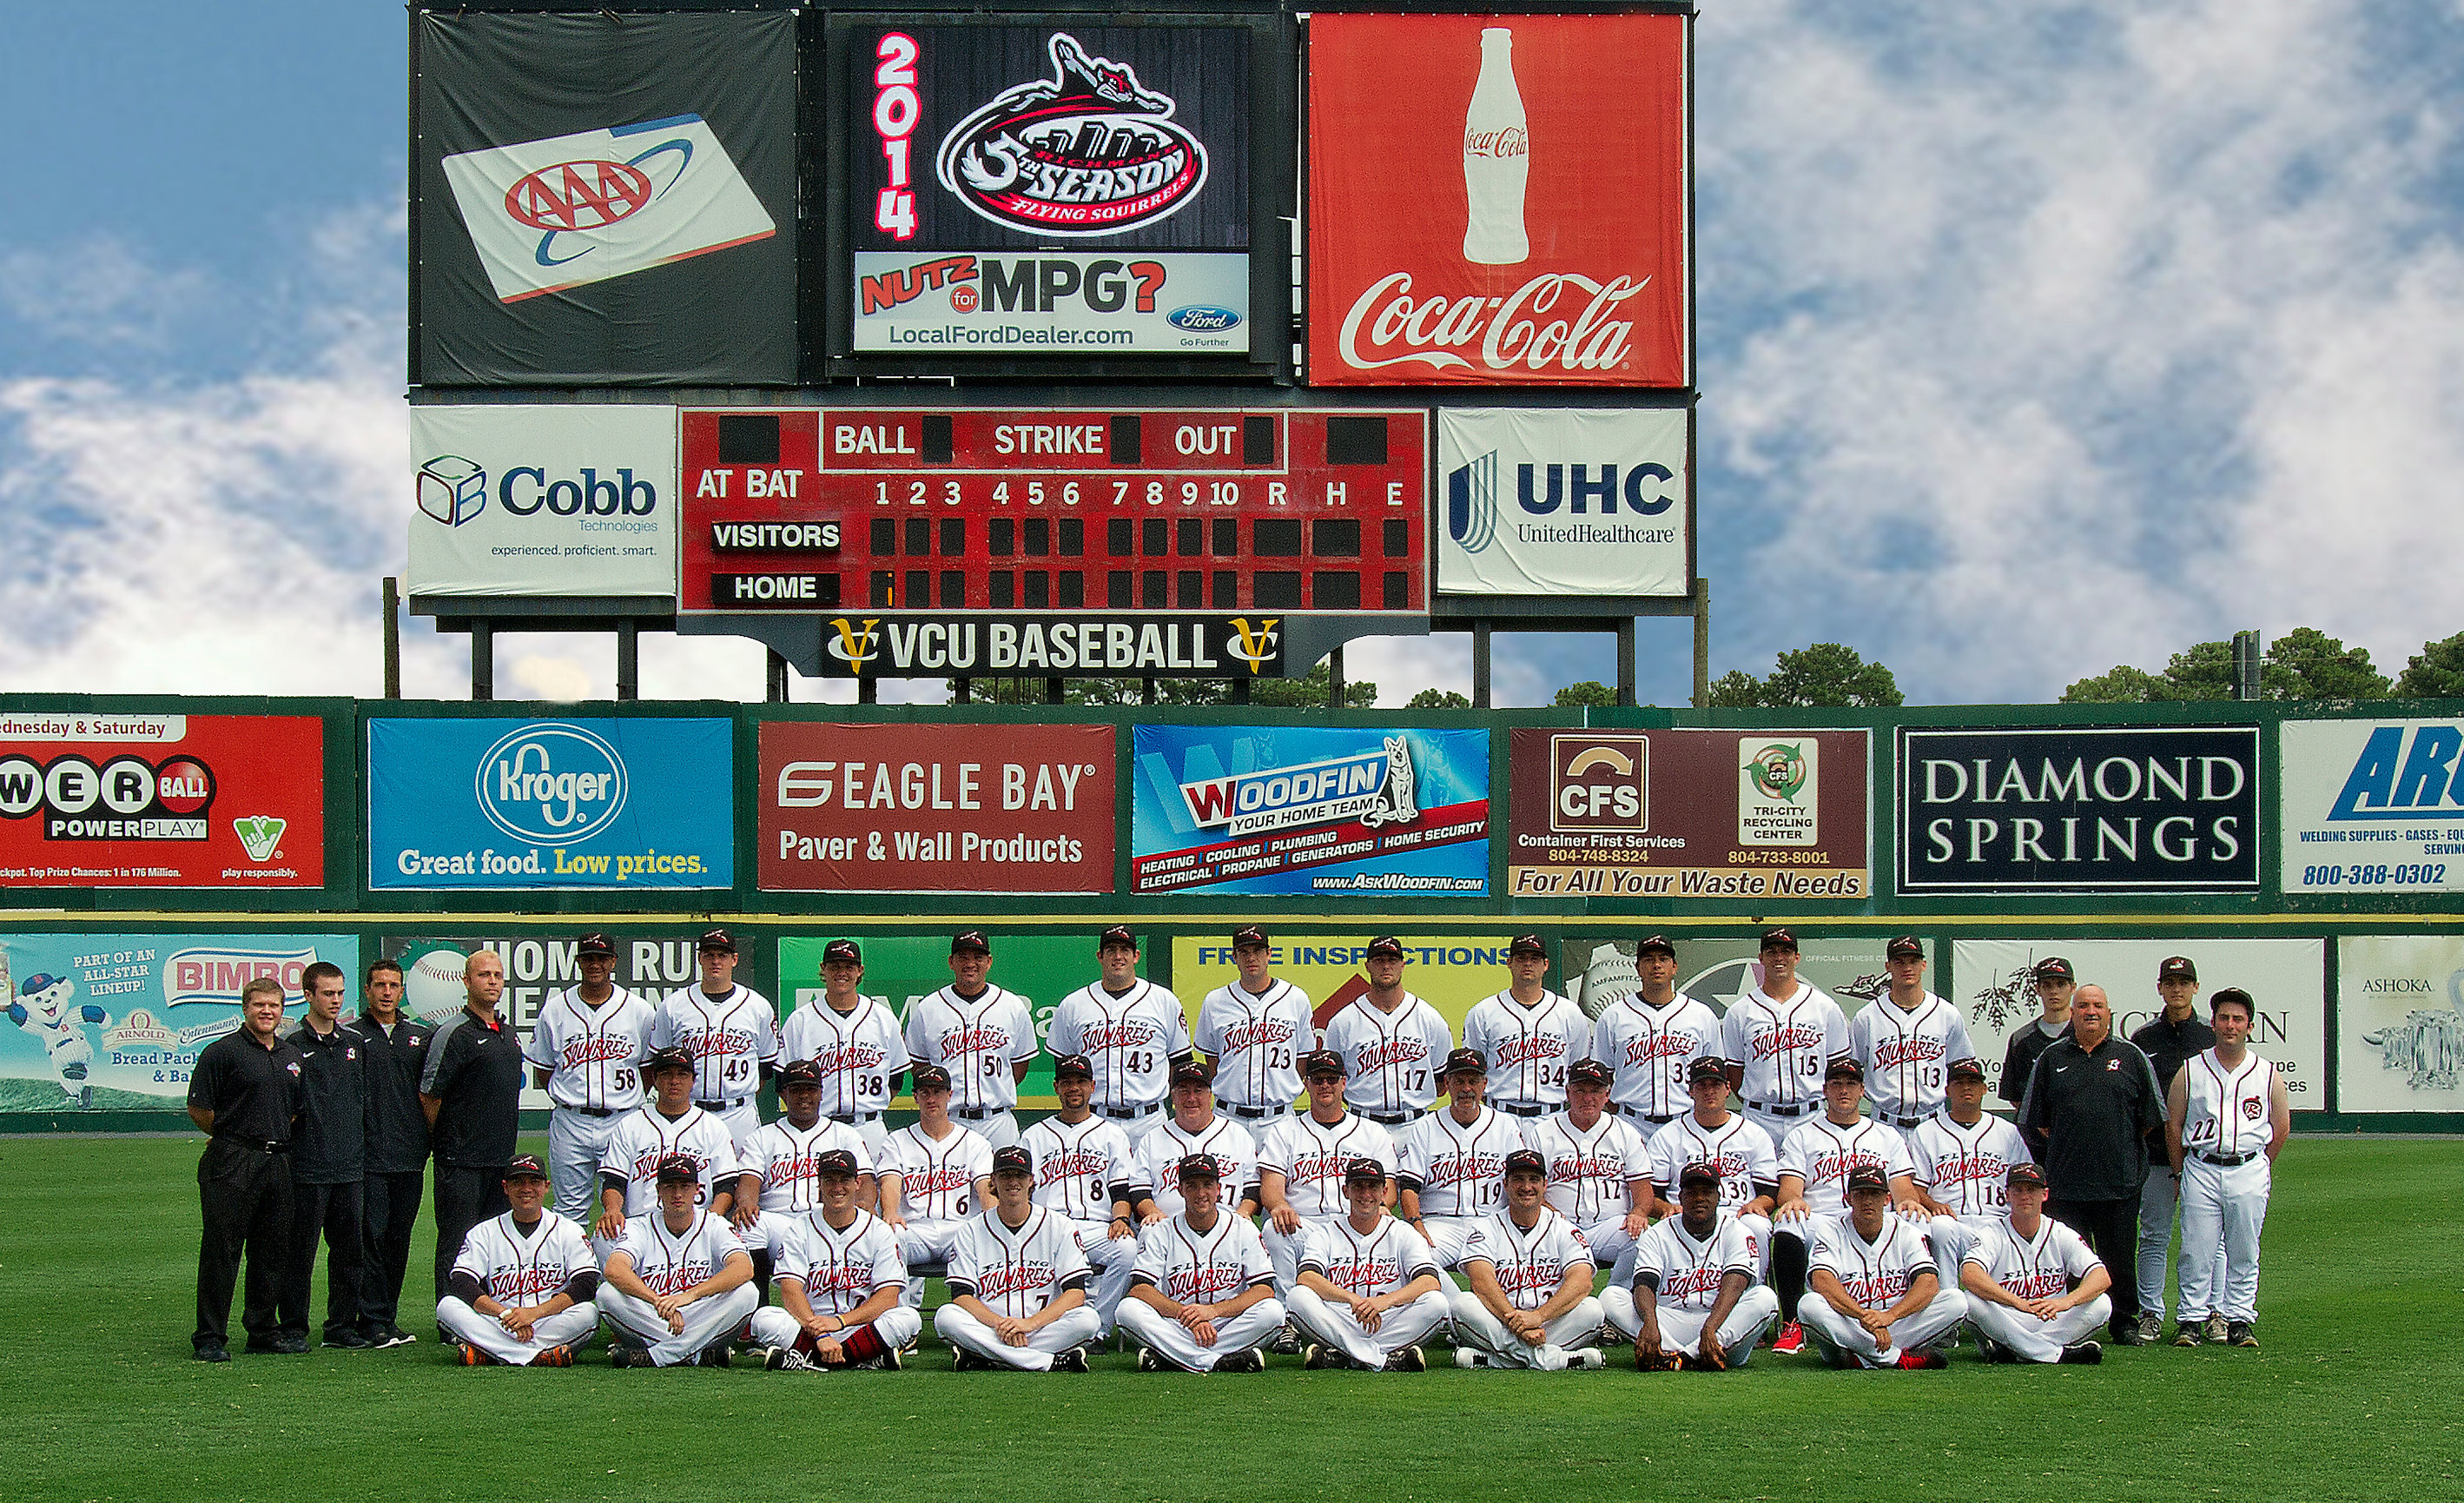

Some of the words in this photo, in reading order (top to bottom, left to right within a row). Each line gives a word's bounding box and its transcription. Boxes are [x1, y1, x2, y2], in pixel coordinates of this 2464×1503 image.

[874, 33, 920, 240] 2014
[1465, 127, 1527, 159] Coca-Cola
[1022, 149, 1186, 202] SEASON
[526, 162, 635, 228] AAA
[1011, 198, 1087, 221] FLYING
[1090, 173, 1188, 221] SQUIRRELS
[860, 255, 979, 315] NUTZ
[954, 291, 976, 307] for
[981, 259, 1167, 314] MPG?
[1180, 308, 1227, 328] Ford
[1338, 271, 1652, 371] Coca-Cola
[889, 324, 1133, 345] LocalFordDealer.com
[1180, 338, 1193, 347] Go
[1195, 338, 1229, 347] Further
[835, 427, 915, 455] BALL
[994, 426, 1104, 455] STRIKE
[1174, 426, 1237, 455] OUT
[499, 466, 657, 516] Cobb
[697, 470, 733, 499] AT
[746, 470, 803, 499] BAT
[875, 482, 890, 505] 1
[908, 482, 927, 505] 2
[943, 482, 961, 505] 3
[992, 482, 1010, 505] 4
[1027, 482, 1045, 505] 5
[1062, 482, 1080, 505] 6
[1113, 482, 1129, 505] 7
[1146, 482, 1164, 505] 8
[1181, 482, 1198, 505] 9
[1210, 482, 1239, 505] 10
[1268, 482, 1287, 505] R
[1327, 482, 1346, 505] H
[1387, 482, 1404, 505] E
[1517, 462, 1674, 515] UHC
[578, 520, 658, 534] Technologies
[713, 525, 841, 548] VISITORS
[1517, 525, 1676, 544] UnitedHealthcare
[492, 545, 561, 559] experienced.
[564, 545, 619, 559] proficient.
[622, 546, 657, 557] smart.
[735, 577, 816, 600] HOME
[888, 623, 976, 669] VCU
[989, 623, 1217, 669] BASEBALL
[0, 719, 69, 737] dnesday
[76, 721, 87, 734] &
[93, 721, 165, 738] Saturday
[499, 742, 611, 826] Kroger
[1769, 771, 1788, 781] CFS
[1921, 756, 2245, 804] DIAMOND
[2326, 726, 2464, 821] AR
[159, 777, 208, 798] BALL
[843, 762, 981, 810] EAGLE
[1186, 762, 1377, 822] WOODFIN
[1560, 785, 1640, 818] CFS
[1754, 807, 1807, 816] TRI-CITY
[1234, 815, 1277, 832] YOUR
[1280, 807, 1328, 825] HOME
[1331, 798, 1373, 818] TEAM
[1743, 818, 1813, 827] RECYCLING
[1518, 835, 1587, 848] Container
[1590, 836, 1623, 848] First
[1626, 835, 1686, 849] Services
[1754, 831, 1803, 839] CENTER
[1926, 816, 2239, 864] SPRINGS
[2300, 831, 2346, 842] WELDING
[2348, 830, 2397, 841] SUPPLIES
[2406, 830, 2439, 841] GASES
[780, 831, 857, 861] Paver
[867, 831, 886, 861] &
[895, 831, 952, 861] Wall
[962, 832, 1083, 863] Products
[1140, 854, 1195, 875] HEATING
[1206, 843, 1260, 864] COOLING
[1272, 831, 1338, 853] PLUMBING
[1140, 868, 1212, 890] ELECTRICAL
[1222, 857, 1281, 876] PROPANE
[1291, 841, 1374, 864] GENERATORS
[1384, 831, 1423, 849] HOME
[1424, 820, 1486, 842] SECURITY
[1549, 850, 1648, 863] 804-748-8324
[1727, 851, 1829, 864] 804-733-8001
[2424, 844, 2464, 855] SERVIN
[29, 868, 44, 879] Top
[121, 868, 129, 877] in
[148, 868, 182, 877] Million.
[222, 869, 241, 880] play
[243, 869, 298, 880] responsibly.
[397, 850, 475, 875] Great
[481, 850, 546, 874] food.
[553, 849, 611, 874] Low
[617, 850, 708, 880] prices.
[2303, 864, 2446, 885] 800-388-0302
[1516, 870, 1562, 893] For
[1565, 870, 1602, 893] All
[1611, 871, 1674, 894] Your
[1681, 871, 1766, 896] Waste
[1773, 871, 1860, 896] Needs
[74, 952, 105, 968] PART
[108, 951, 132, 964] OF
[136, 950, 155, 962] AN
[631, 940, 702, 981] RU
[1199, 947, 1284, 965] FRE
[84, 965, 149, 983] ALL-STAR
[90, 980, 146, 996] LINEUP!
[2362, 979, 2432, 992] ASHOKA
[116, 1030, 165, 1040] ARNOLD
[179, 1015, 241, 1043] Entenmann's
[112, 1052, 158, 1065] Bread
[983, 1055, 1002, 1077] 50
[1126, 1051, 1153, 1074] 43
[1270, 1048, 1291, 1069] 23
[1799, 1056, 1819, 1076] 15
[153, 1069, 165, 1083] &
[614, 1069, 637, 1090] 58
[724, 1060, 749, 1082] 49
[1404, 1069, 1427, 1091] 17
[1539, 1064, 1565, 1088] 34
[1921, 1067, 1941, 1088] 13
[858, 1074, 883, 1096] 38
[2191, 1118, 2215, 1142] 22
[1090, 1180, 1104, 1202] 8
[1481, 1182, 1502, 1205] 19
[1602, 1180, 1622, 1200] 12
[1985, 1185, 2005, 1207] 18
[956, 1195, 969, 1215] 6
